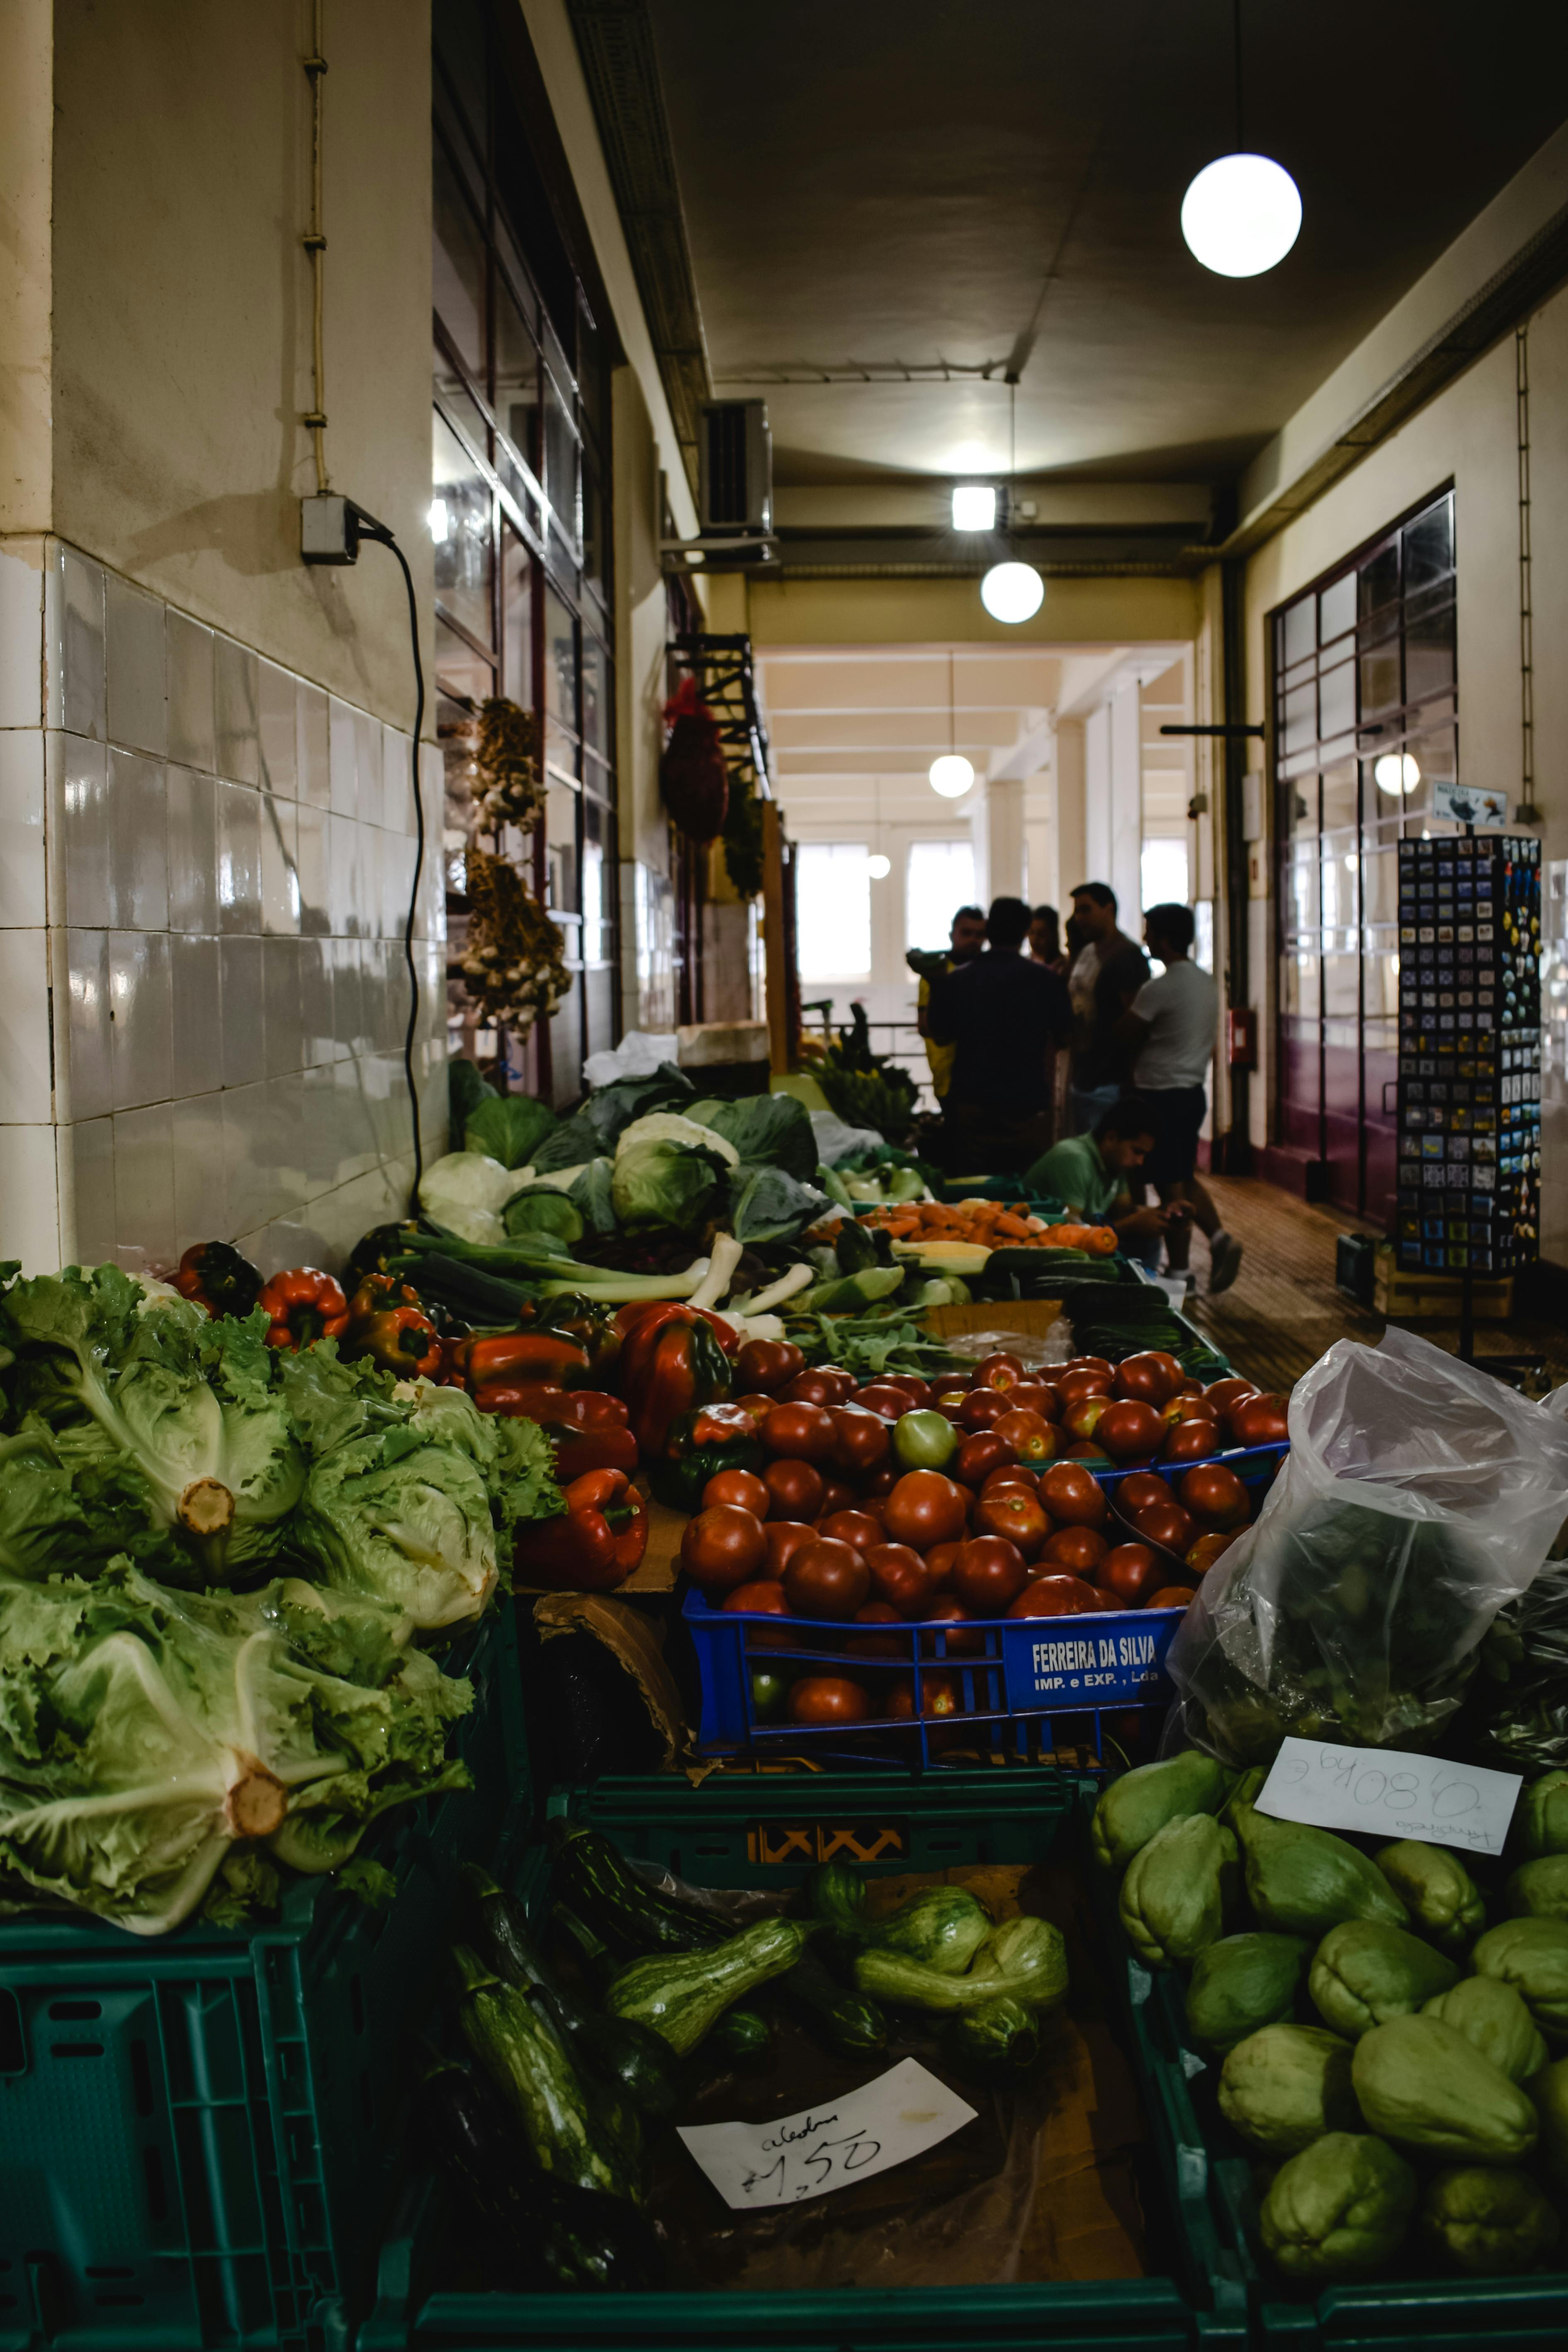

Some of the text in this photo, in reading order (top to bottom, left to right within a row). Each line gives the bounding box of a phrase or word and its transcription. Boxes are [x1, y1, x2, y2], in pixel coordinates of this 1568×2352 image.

[1032, 1635, 1157, 1673] FERREIRA DA SILVA
[1035, 1677, 1066, 1691] IMP.
[1070, 1678, 1079, 1688] e
[1084, 1673, 1117, 1687] EXP.
[1131, 1670, 1158, 1683] Lda
